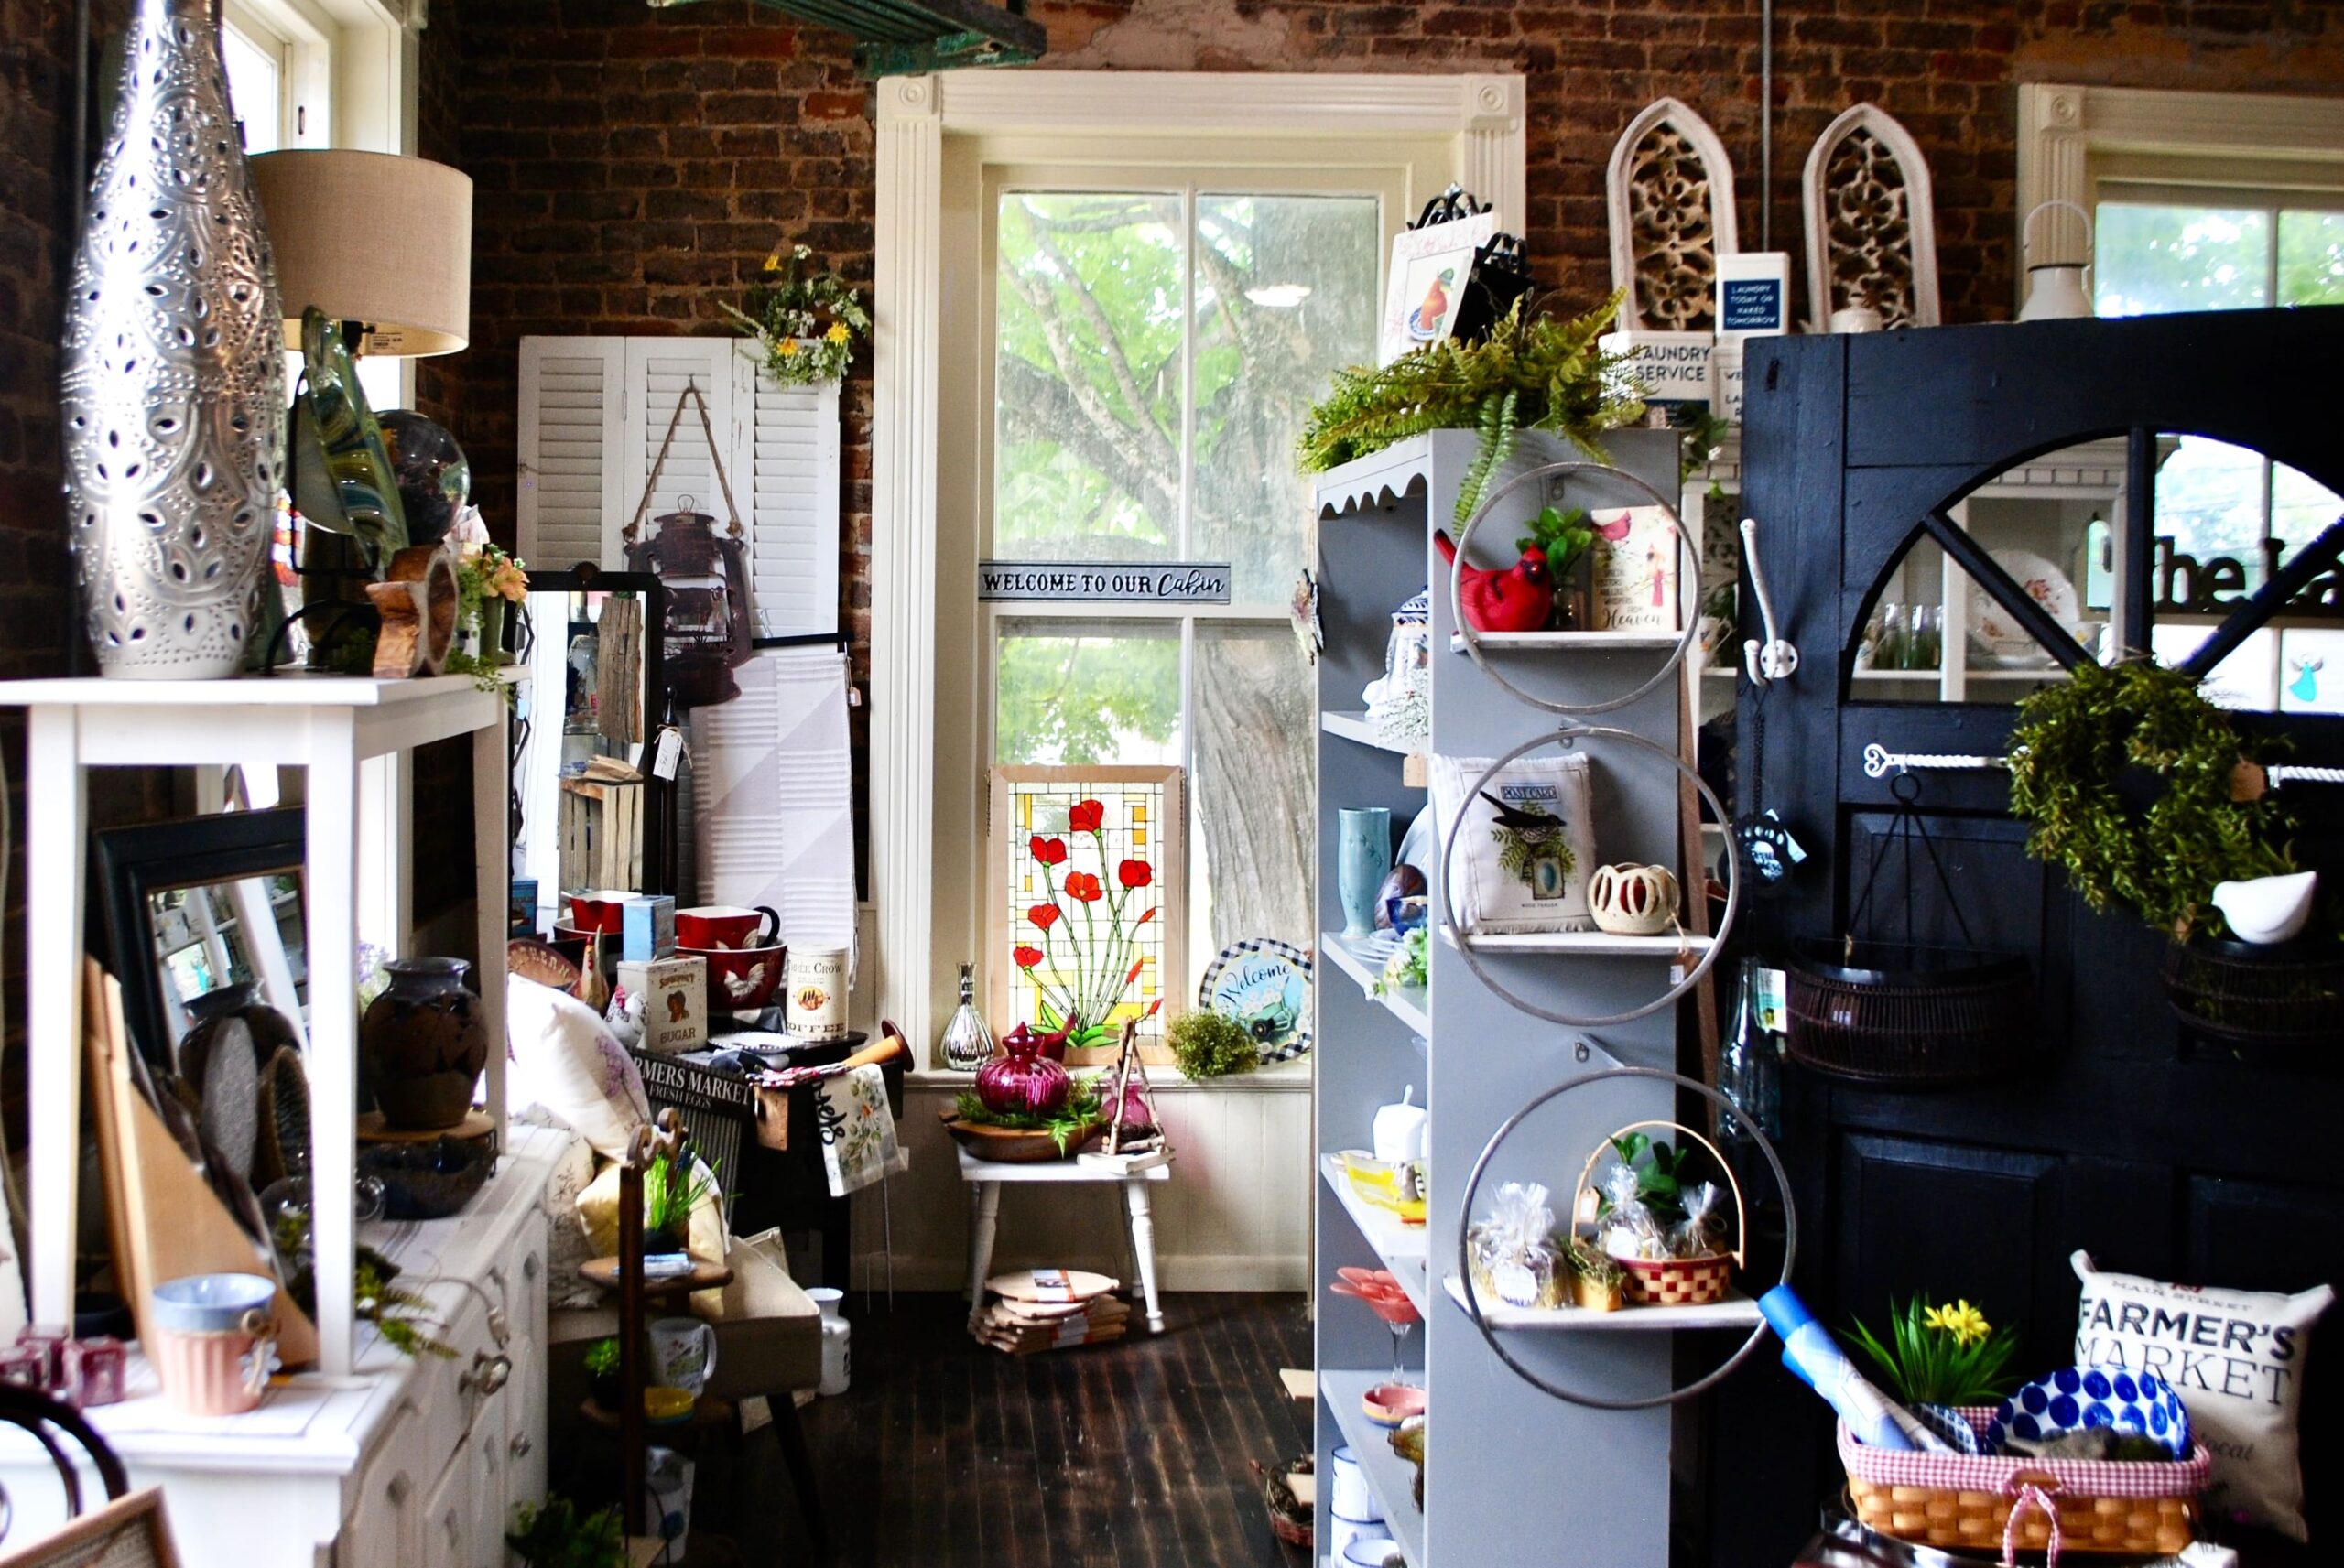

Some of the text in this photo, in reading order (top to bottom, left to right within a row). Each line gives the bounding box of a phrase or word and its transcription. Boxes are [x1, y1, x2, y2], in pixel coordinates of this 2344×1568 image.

[1730, 295, 1758, 304] TODAY
[1731, 285, 1772, 294] LAUNDRY
[1726, 316, 1777, 324] TOMORROW
[1635, 366, 1705, 381] SERVICE
[983, 569, 1225, 596] WELCOME TO OUR Cabin
[1603, 608, 1662, 629] Heaven
[1503, 787, 1556, 799] POST CARD
[814, 962, 841, 974] CROW
[1216, 965, 1290, 1007] Welcome
[634, 1057, 751, 1105] RMERS MARKET
[649, 1083, 711, 1109] FRESH EGGS
[2111, 1281, 2165, 1297] MAIN
[2173, 1292, 2253, 1312] STREET
[2081, 1298, 2296, 1361] FARMER'S
[2077, 1336, 2293, 1406] MARKET
